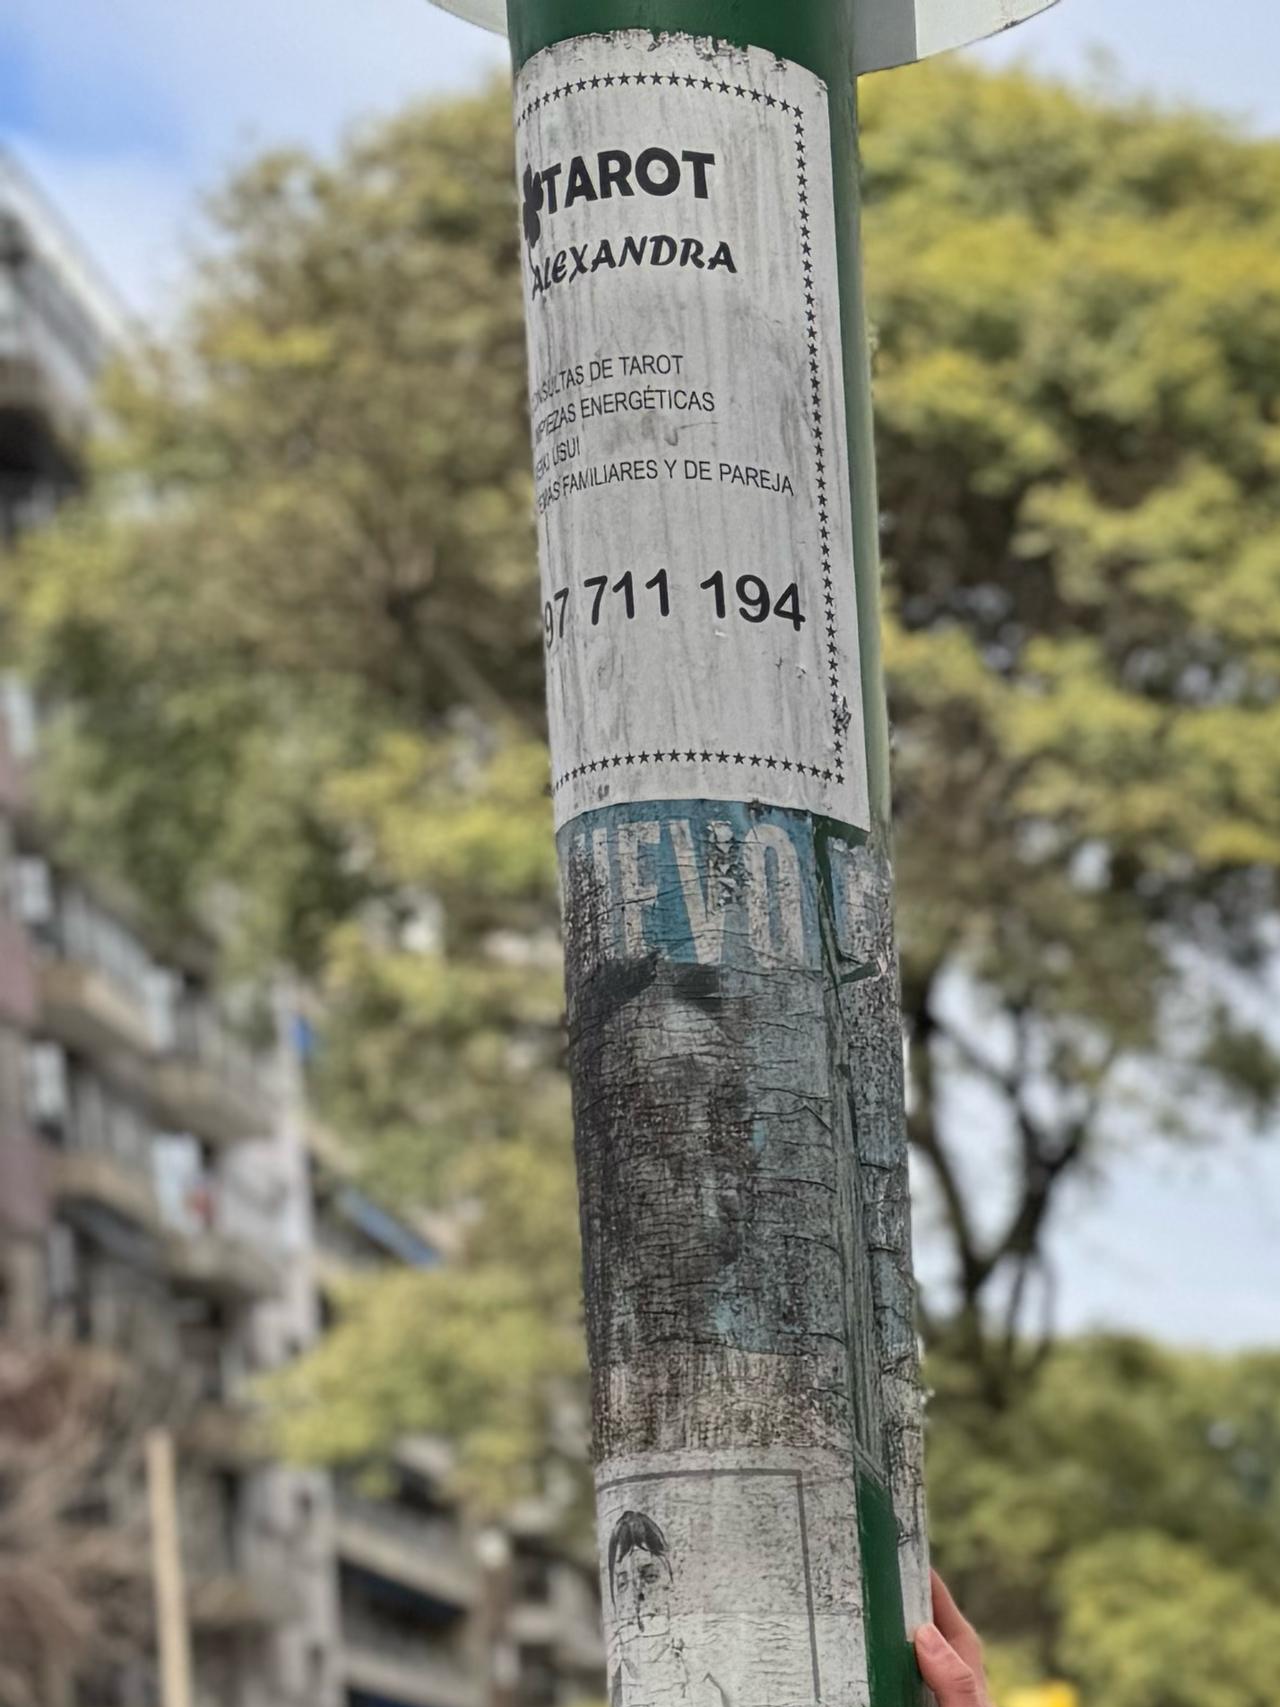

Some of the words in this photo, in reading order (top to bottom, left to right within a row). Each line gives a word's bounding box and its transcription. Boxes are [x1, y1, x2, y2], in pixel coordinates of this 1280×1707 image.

[541, 147, 716, 214] TAROT
[589, 358, 613, 381] DE
[618, 354, 684, 376] TAROT
[580, 384, 716, 419] ENERGÉTICAS
[562, 459, 659, 497] FAMILIARES
[663, 459, 677, 480] Y
[684, 460, 712, 481] DE
[719, 462, 794, 497] PAREJA
[584, 568, 670, 626] 711
[700, 570, 806, 632] 194
